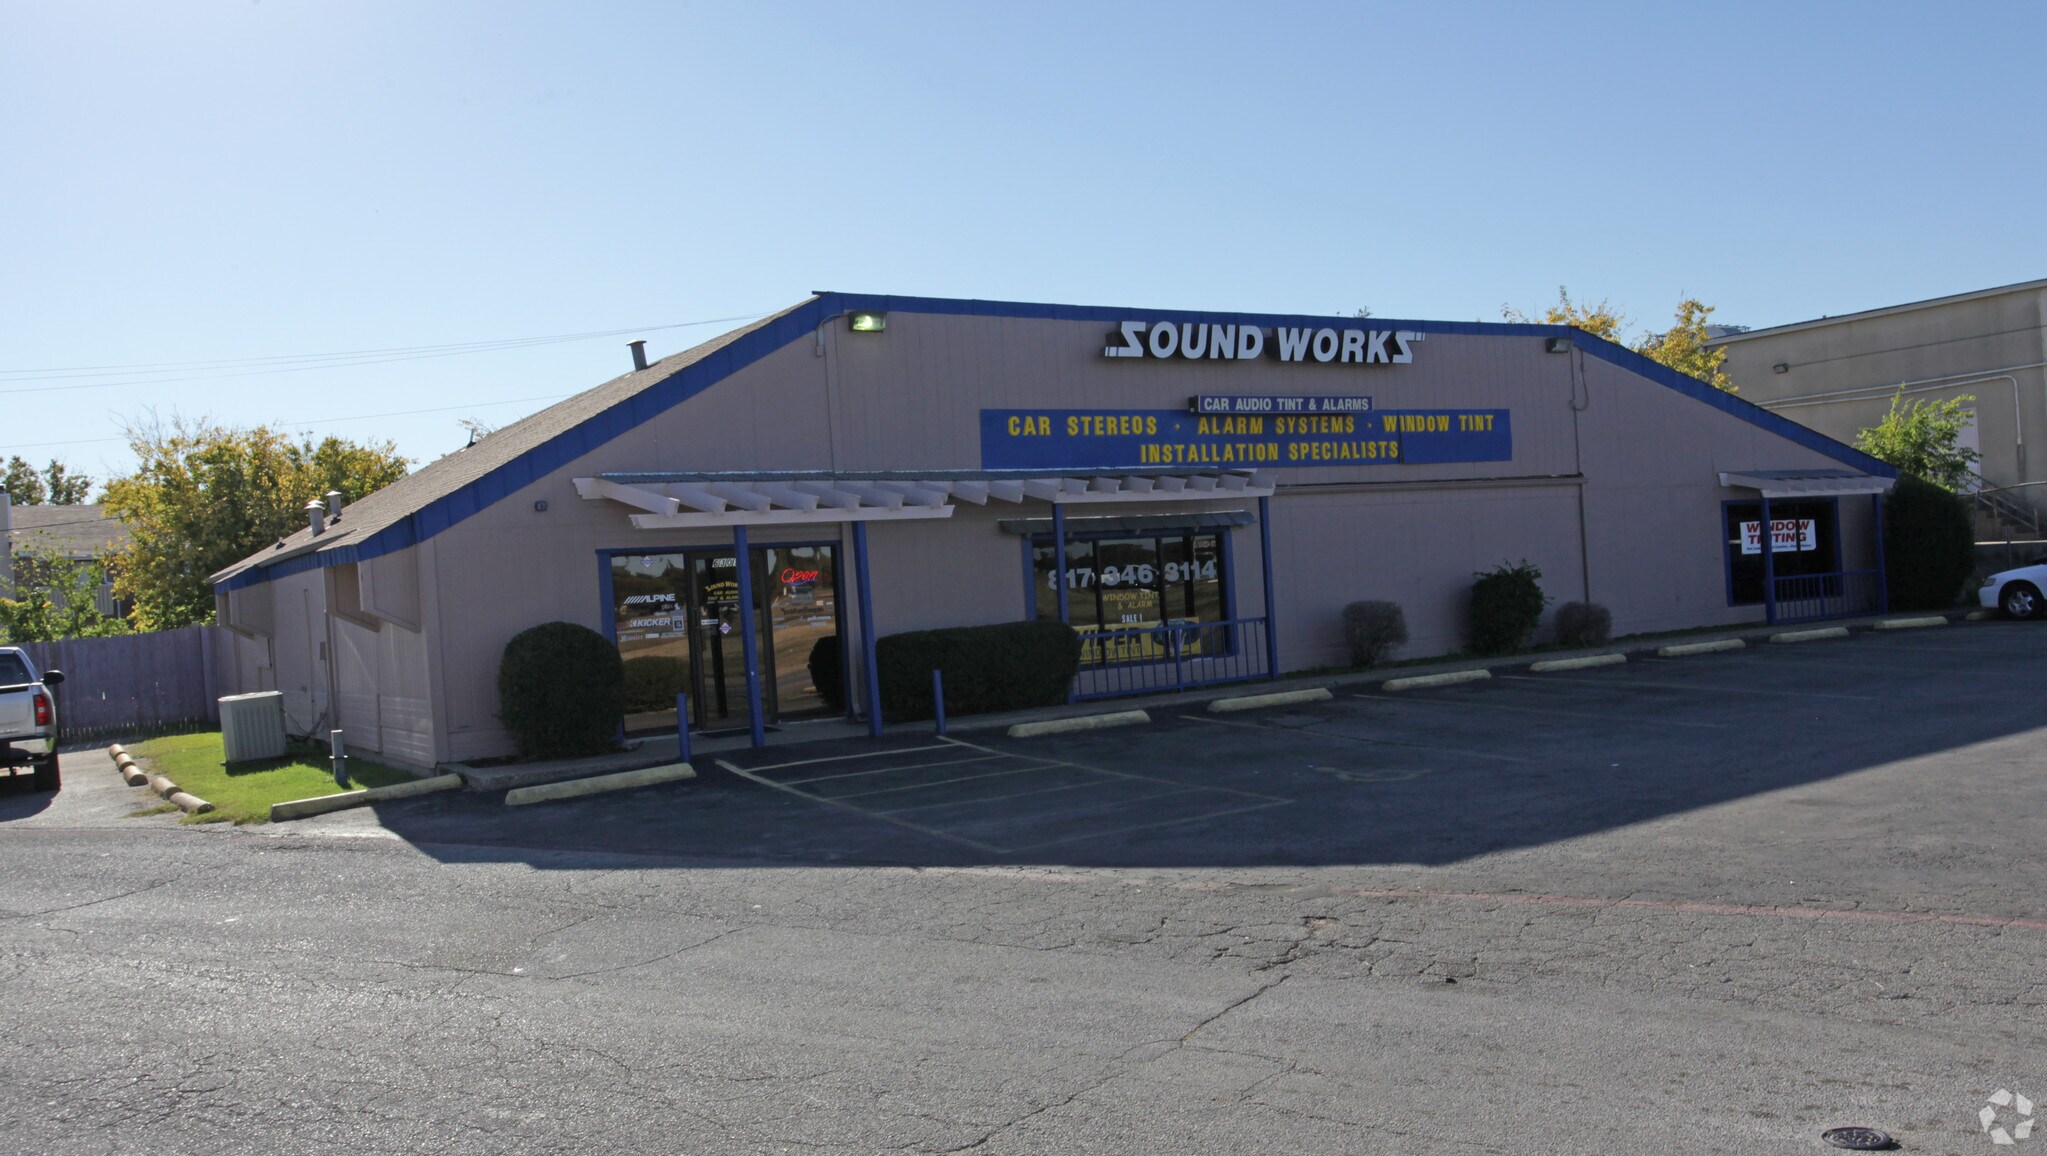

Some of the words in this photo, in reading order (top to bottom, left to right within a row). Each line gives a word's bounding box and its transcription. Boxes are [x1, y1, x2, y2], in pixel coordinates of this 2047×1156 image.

[1105, 320, 1264, 360] SOUND
[1277, 326, 1425, 364] WORKS
[1204, 397, 1229, 411] CAR
[1235, 397, 1272, 411] AUDIO
[1277, 397, 1303, 411] TINT
[1309, 398, 1317, 411] &
[1322, 397, 1369, 411] ALARMS
[1008, 415, 1051, 436] CAR
[1067, 415, 1157, 436] STEREOS
[1197, 416, 1263, 435] ALARM
[1275, 415, 1355, 435] SYSTEMS
[1382, 415, 1450, 433] WINDOW
[1459, 415, 1494, 432] TINT
[1140, 442, 1278, 463] INSTALLATION
[1288, 440, 1399, 461] SPECIALISTS
[1746, 520, 1810, 533] WNDOW
[1748, 532, 1807, 545] TITING
[781, 568, 819, 583] Open
[1048, 567, 1093, 590] 817
[1104, 563, 1154, 587] 346
[638, 593, 676, 604] ALPINE
[1102, 591, 1138, 602] WINDOW
[1139, 591, 1159, 601] TINT
[1127, 601, 1153, 609] ALARM
[637, 617, 671, 628] KICKER
[1121, 614, 1138, 623] SALE
